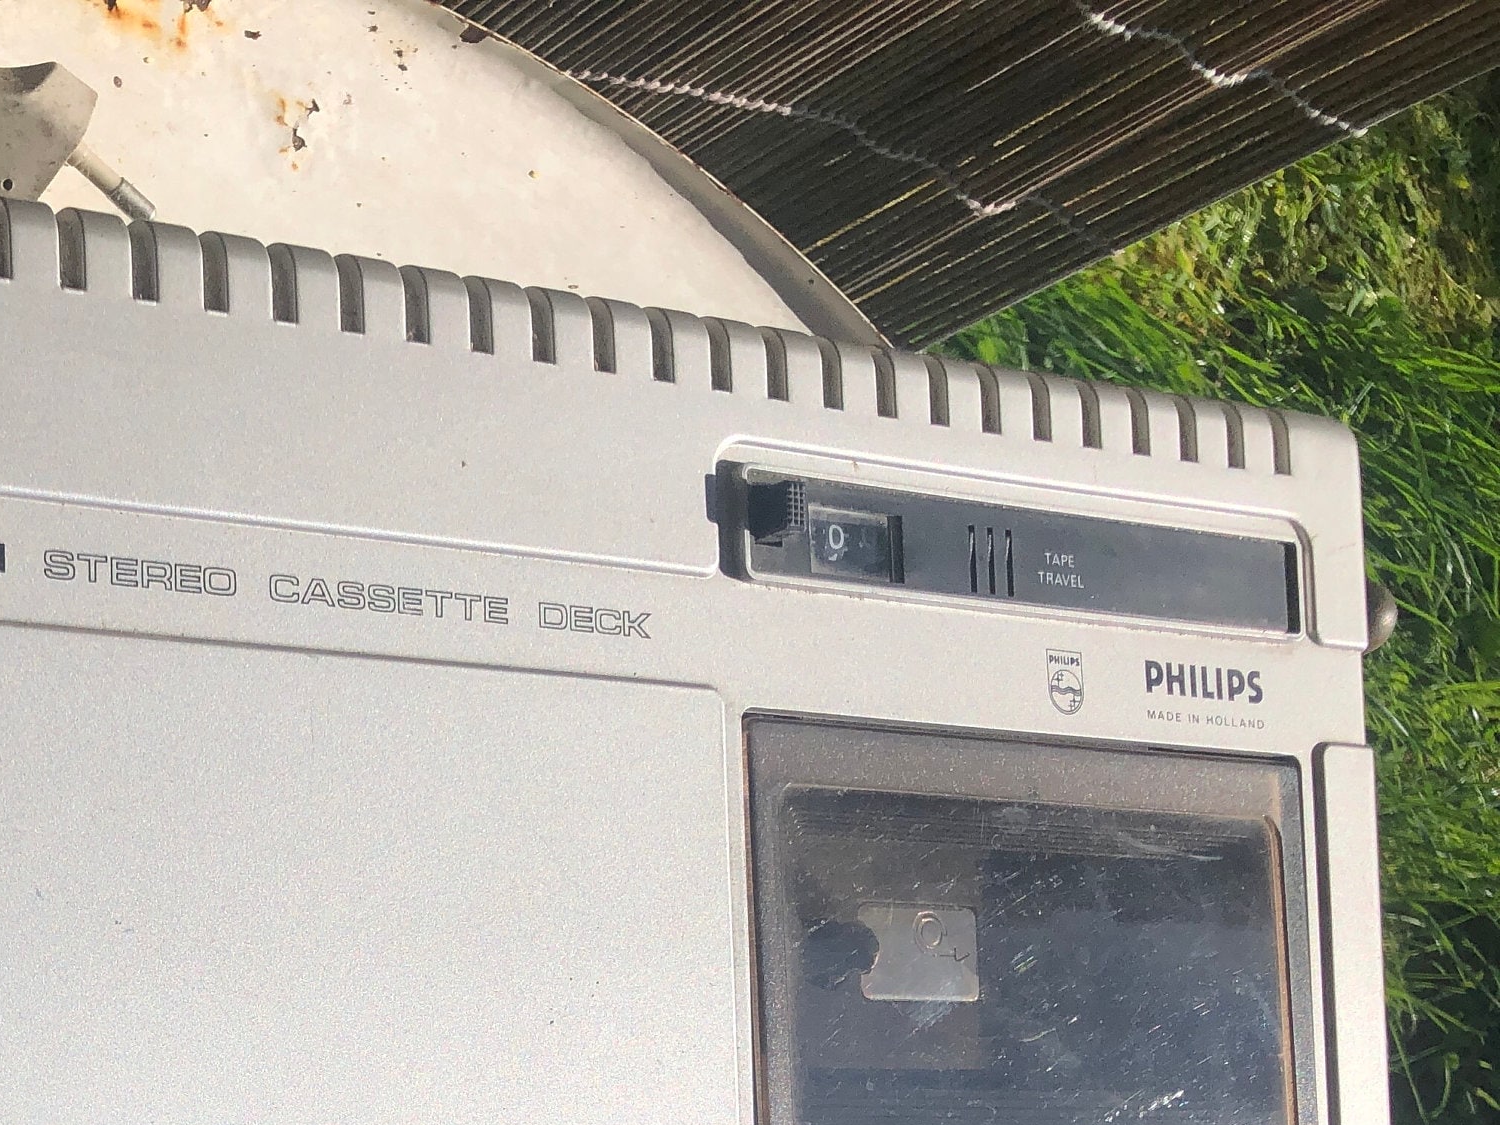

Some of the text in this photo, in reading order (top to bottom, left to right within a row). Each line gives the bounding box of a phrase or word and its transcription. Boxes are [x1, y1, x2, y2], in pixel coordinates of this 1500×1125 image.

[1044, 552, 1075, 568] TAPE
[1038, 571, 1085, 589] TRAVEL
[44, 549, 237, 597] STEREO
[269, 574, 510, 626] CASSETTE
[539, 603, 652, 639] DECK
[1048, 654, 1080, 667] PHILIPS
[1144, 660, 1264, 704] PHILIPS
[1147, 709, 1265, 730] MADE IN HOLLAND
